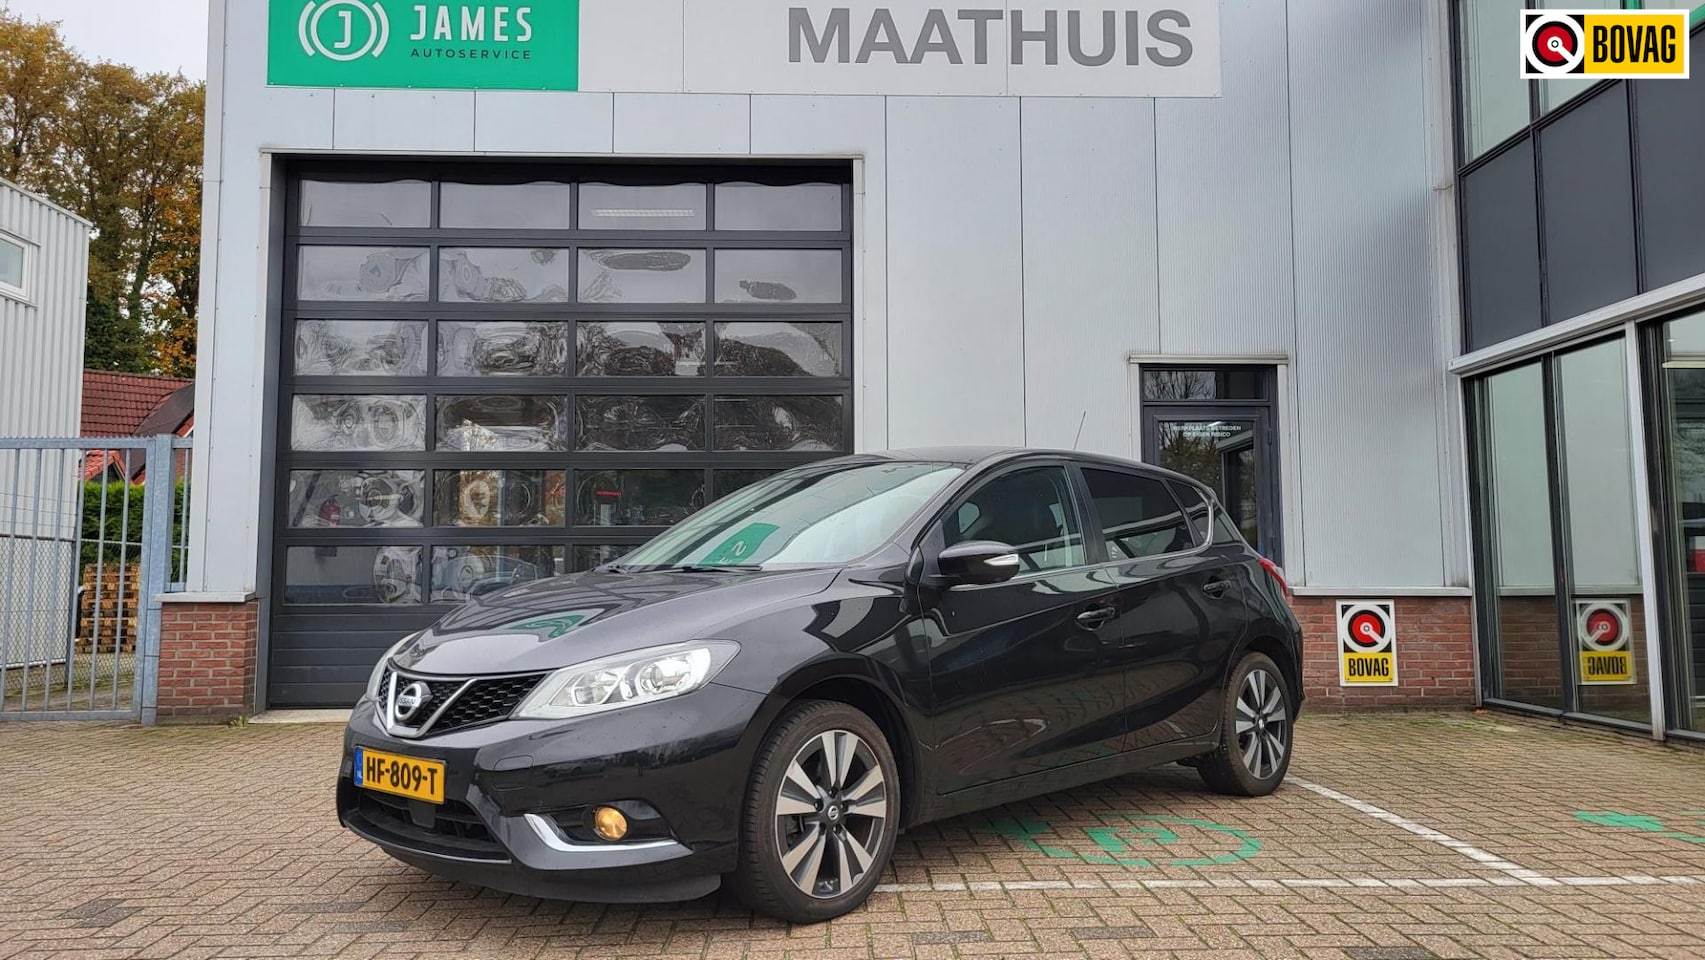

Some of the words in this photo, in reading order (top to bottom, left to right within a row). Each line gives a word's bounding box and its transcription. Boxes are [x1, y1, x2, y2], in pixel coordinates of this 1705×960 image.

[333, 10, 352, 49] J
[410, 5, 533, 42] JAMES
[788, 7, 1194, 67] MAATHUIS
[410, 48, 532, 60] AUTOSERVICE
[1348, 657, 1389, 677] BOVAG
[366, 756, 438, 795] HF-809-T
